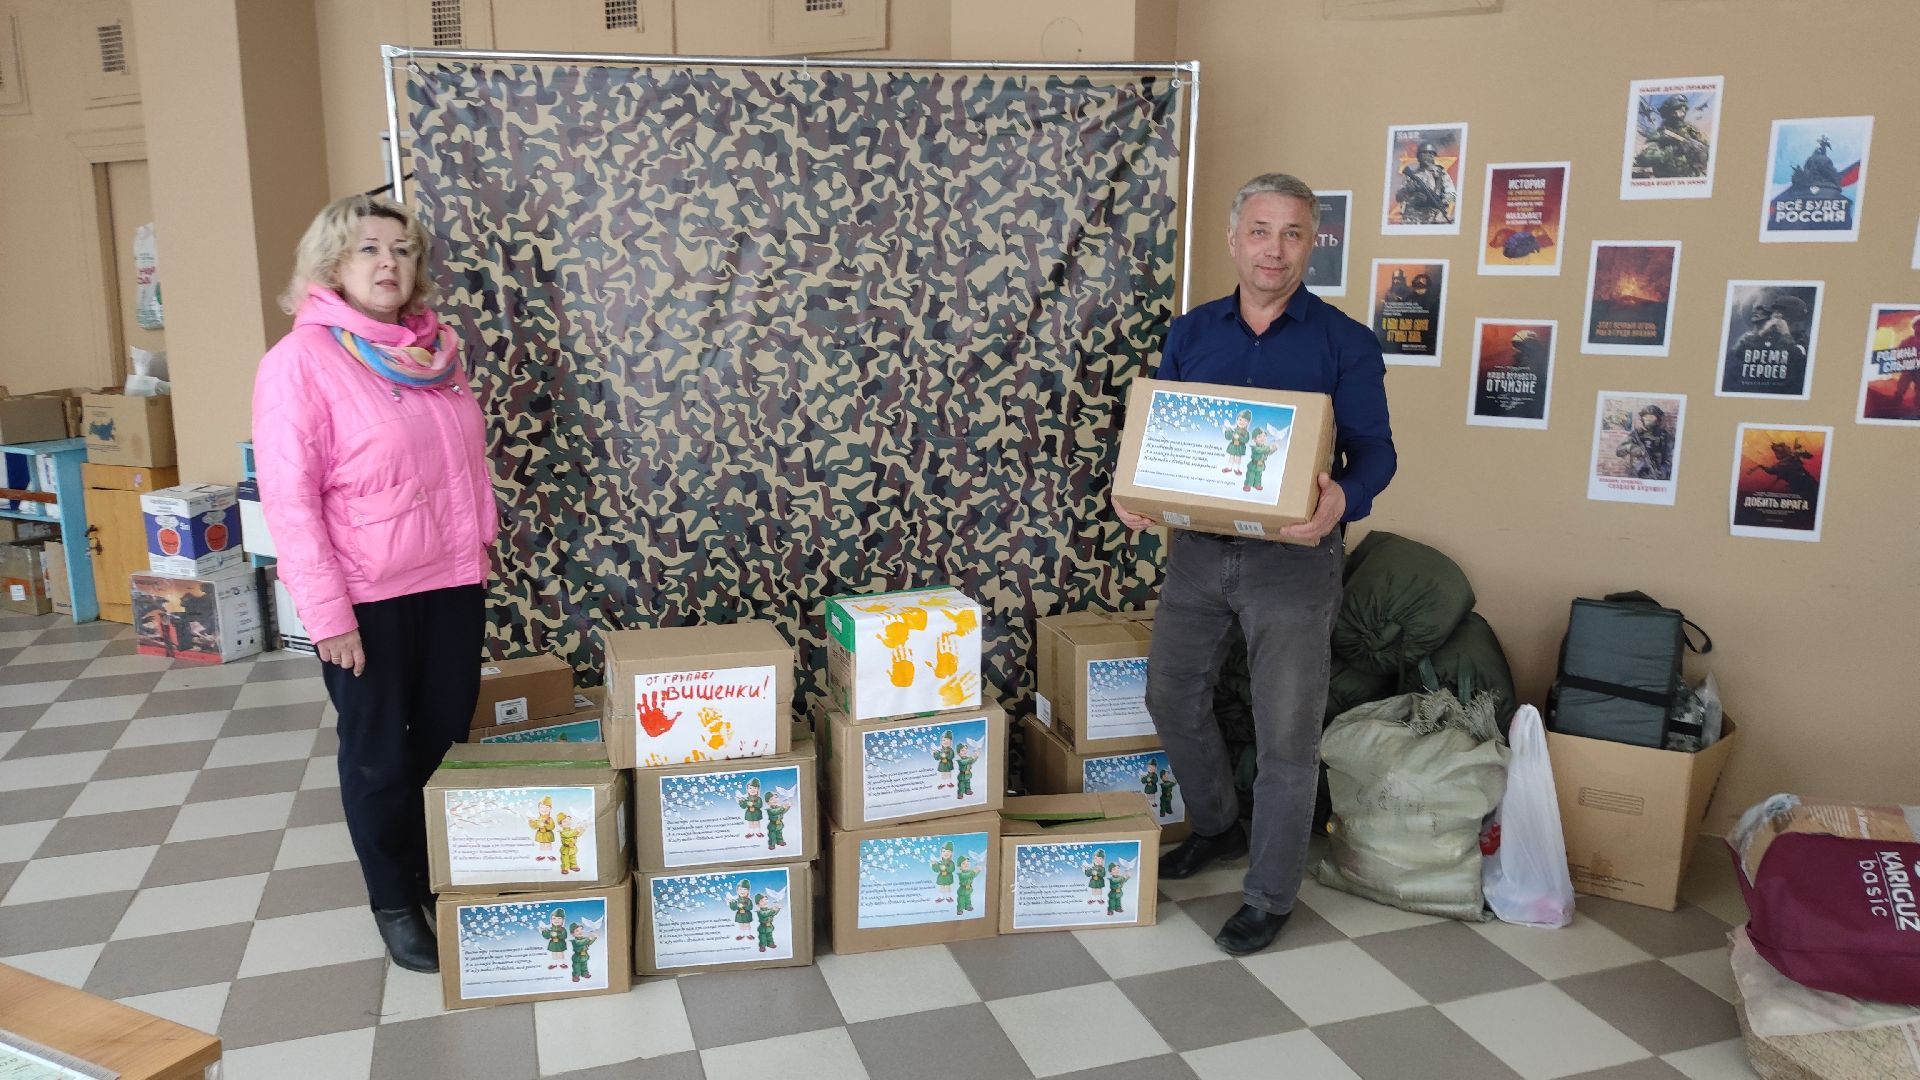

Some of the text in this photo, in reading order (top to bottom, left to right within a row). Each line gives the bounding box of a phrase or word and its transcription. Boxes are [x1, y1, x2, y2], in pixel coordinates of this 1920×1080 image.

[1508, 179, 1546, 190] ИСТОРИЯ
[1776, 199, 1848, 212] ВСЁ БУДЕТ
[1775, 210, 1847, 223] РОССИЯ
[1744, 349, 1789, 365] ВРЕМЯ
[1742, 363, 1787, 379] ГЕРОЕВ
[1486, 379, 1537, 394] ОТЧИЗНЕ
[1743, 496, 1809, 511] ДОБИТЬ ВРАГА
[646, 675, 660, 687] ОТ
[1858, 859, 1890, 918] basic
[1879, 851, 1920, 932] KARIGUZ
